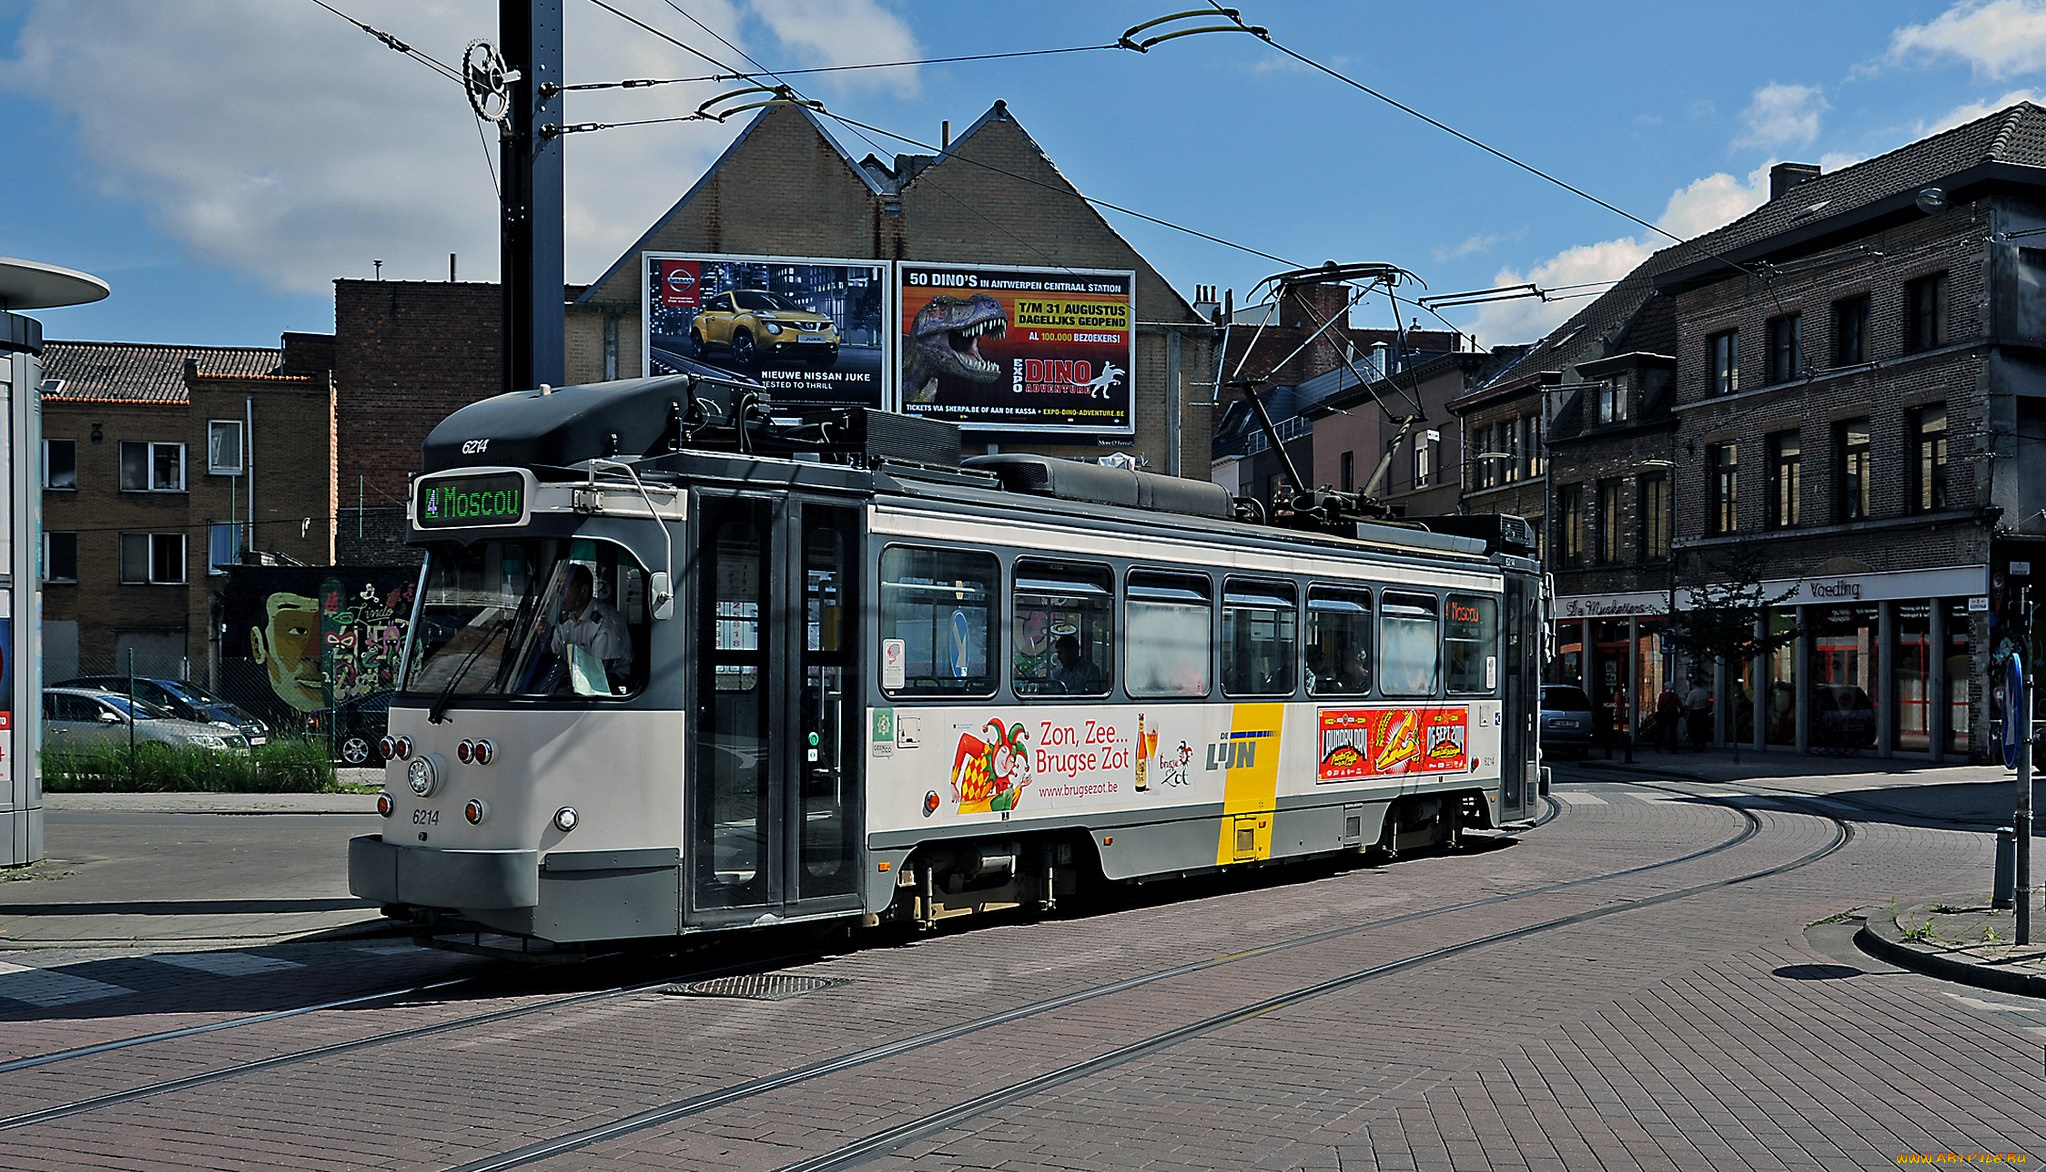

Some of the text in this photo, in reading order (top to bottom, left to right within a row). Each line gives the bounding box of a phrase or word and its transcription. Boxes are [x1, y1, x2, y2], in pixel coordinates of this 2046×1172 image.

[910, 273, 1121, 293] 50 DINO'S IN ANTWERPEN CENTRAAL STATION
[1019, 302, 1126, 316] T/M 31 AUGUSTUS
[1019, 314, 1126, 327] DAGELIJKS GEOPEND
[1029, 332, 1121, 343] AL 100.000 BEZOEKERS!
[761, 370, 871, 382] NIEUWE NISSAN JUKE
[1013, 358, 1023, 393] EXPO
[1024, 358, 1092, 384] DINO
[762, 381, 833, 390] TESTED TO THRILL
[1025, 383, 1091, 394] ADVENTURE
[906, 404, 932, 412] TICKETS
[945, 405, 980, 413] SHERPA.BE
[1015, 407, 1037, 415] KASSA
[1043, 408, 1125, 417] EXPO-DINO-ADVENTURE.BE
[462, 438, 490, 455] 6214
[444, 485, 519, 518] Moscou
[1810, 580, 1861, 600] Voeding
[1566, 600, 1584, 617] De
[1040, 720, 1129, 748] Zon, Zee...
[1220, 732, 1229, 740] DE
[1036, 746, 1129, 779] Brugse Zot
[1205, 741, 1257, 771] LIJN
[1039, 781, 1119, 798] www.brugsezot.be
[412, 808, 440, 826] 6214
